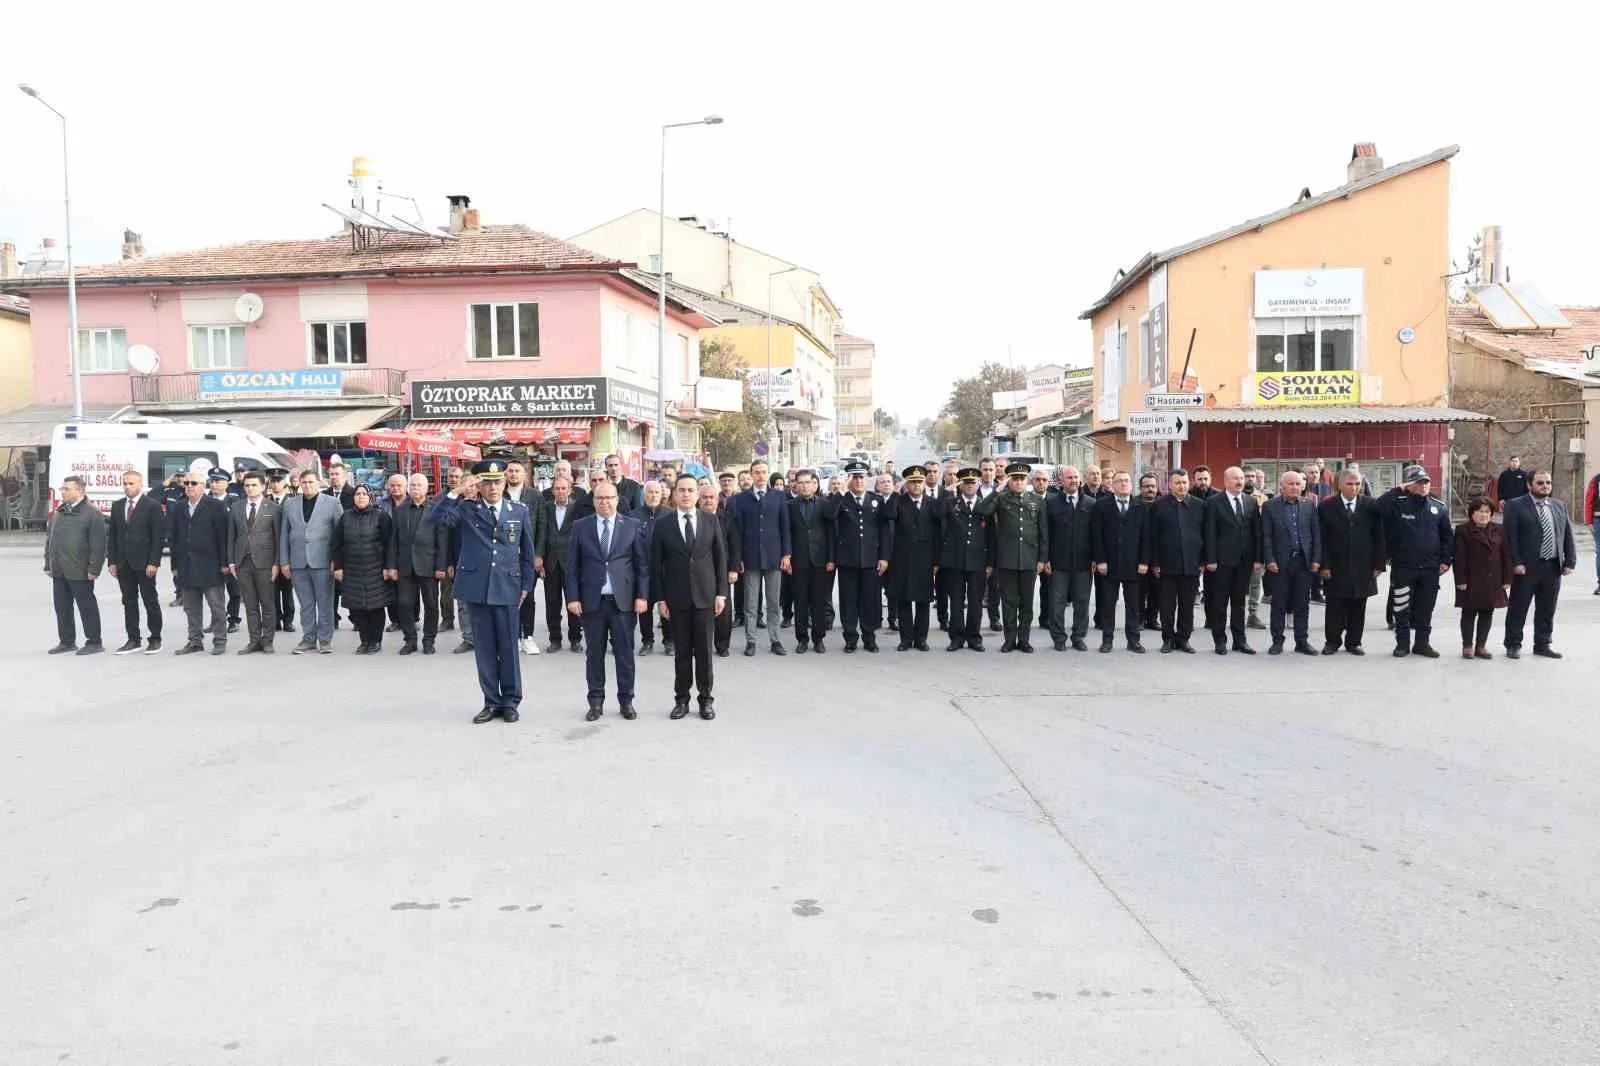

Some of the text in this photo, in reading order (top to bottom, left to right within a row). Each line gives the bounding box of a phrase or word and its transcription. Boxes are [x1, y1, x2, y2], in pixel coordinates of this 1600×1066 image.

[221, 370, 296, 387] ÖZCAN
[301, 373, 337, 385] HALI
[1281, 374, 1355, 385] SOYKAN
[421, 384, 517, 403] ÖZTOPRAK
[520, 384, 597, 401] MARKET
[1283, 386, 1352, 395] EMLAK
[1157, 396, 1191, 405] Hastane
[423, 403, 507, 415] Tavukçuluk
[511, 403, 523, 412] &
[526, 400, 597, 414] Şarküteri
[1130, 416, 1154, 425] Kayseri
[71, 460, 96, 472] SAĞLIK
[95, 472, 122, 487] SAĞLI
